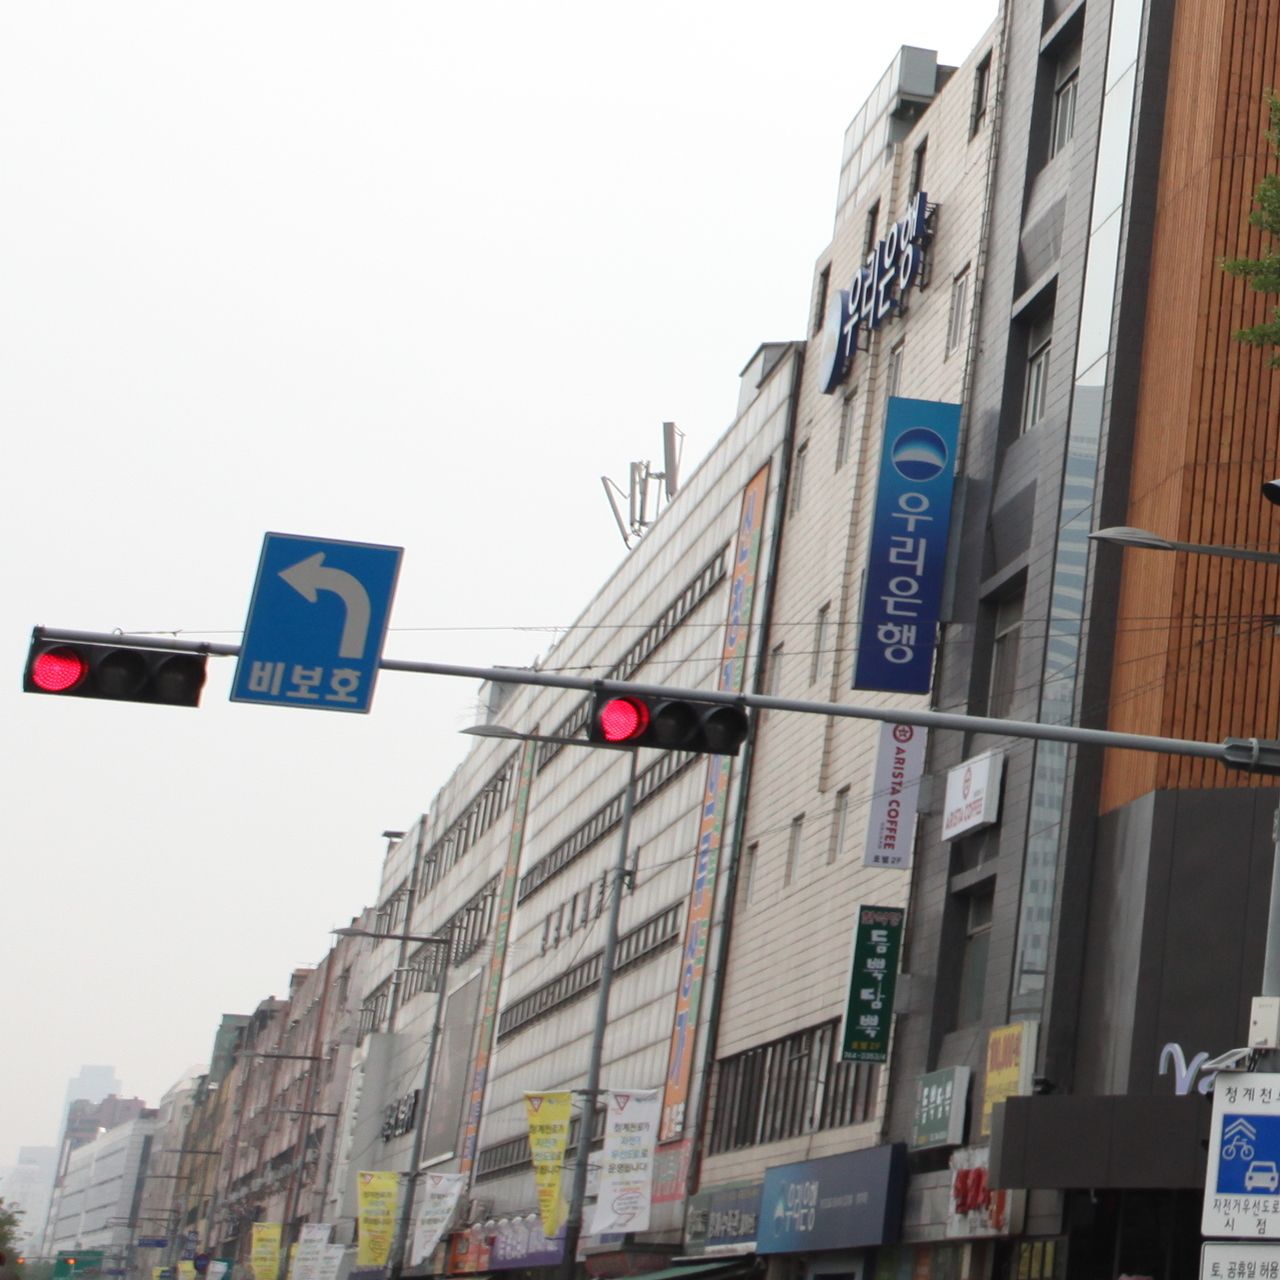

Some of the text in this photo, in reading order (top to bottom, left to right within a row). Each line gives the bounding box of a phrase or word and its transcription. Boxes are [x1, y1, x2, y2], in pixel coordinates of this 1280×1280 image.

[843, 192, 922, 358] 우리은행
[877, 492, 934, 665] 우리은행
[247, 659, 362, 704] 비보호
[882, 745, 907, 851] ARISTA COFFEE
[1213, 1198, 1280, 1216] 자전거우선도로
[1227, 1261, 1256, 1280] 공휴일
